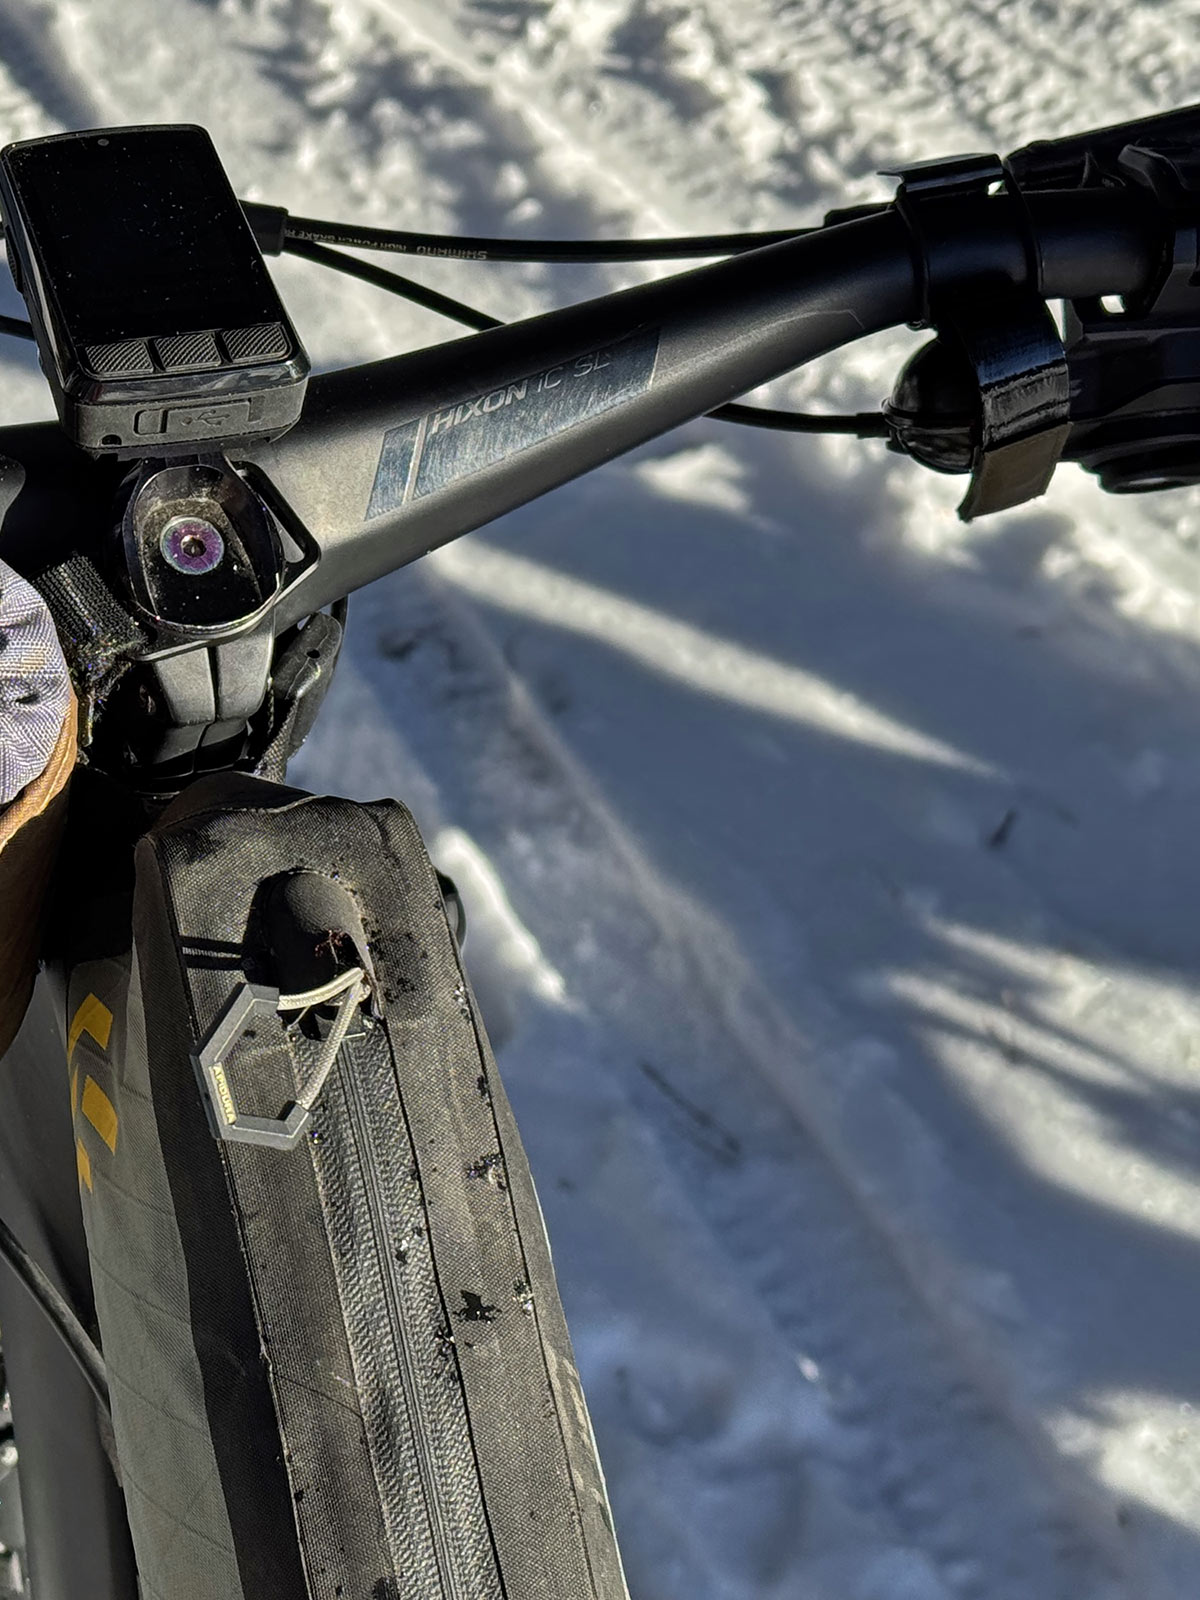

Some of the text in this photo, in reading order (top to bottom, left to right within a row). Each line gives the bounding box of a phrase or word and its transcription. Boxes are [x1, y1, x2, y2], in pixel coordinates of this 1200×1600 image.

[416, 245, 488, 260] SHIMANO
[431, 380, 528, 434] HIXON
[573, 352, 611, 378] SL
[212, 1065, 237, 1124] APIDURA
